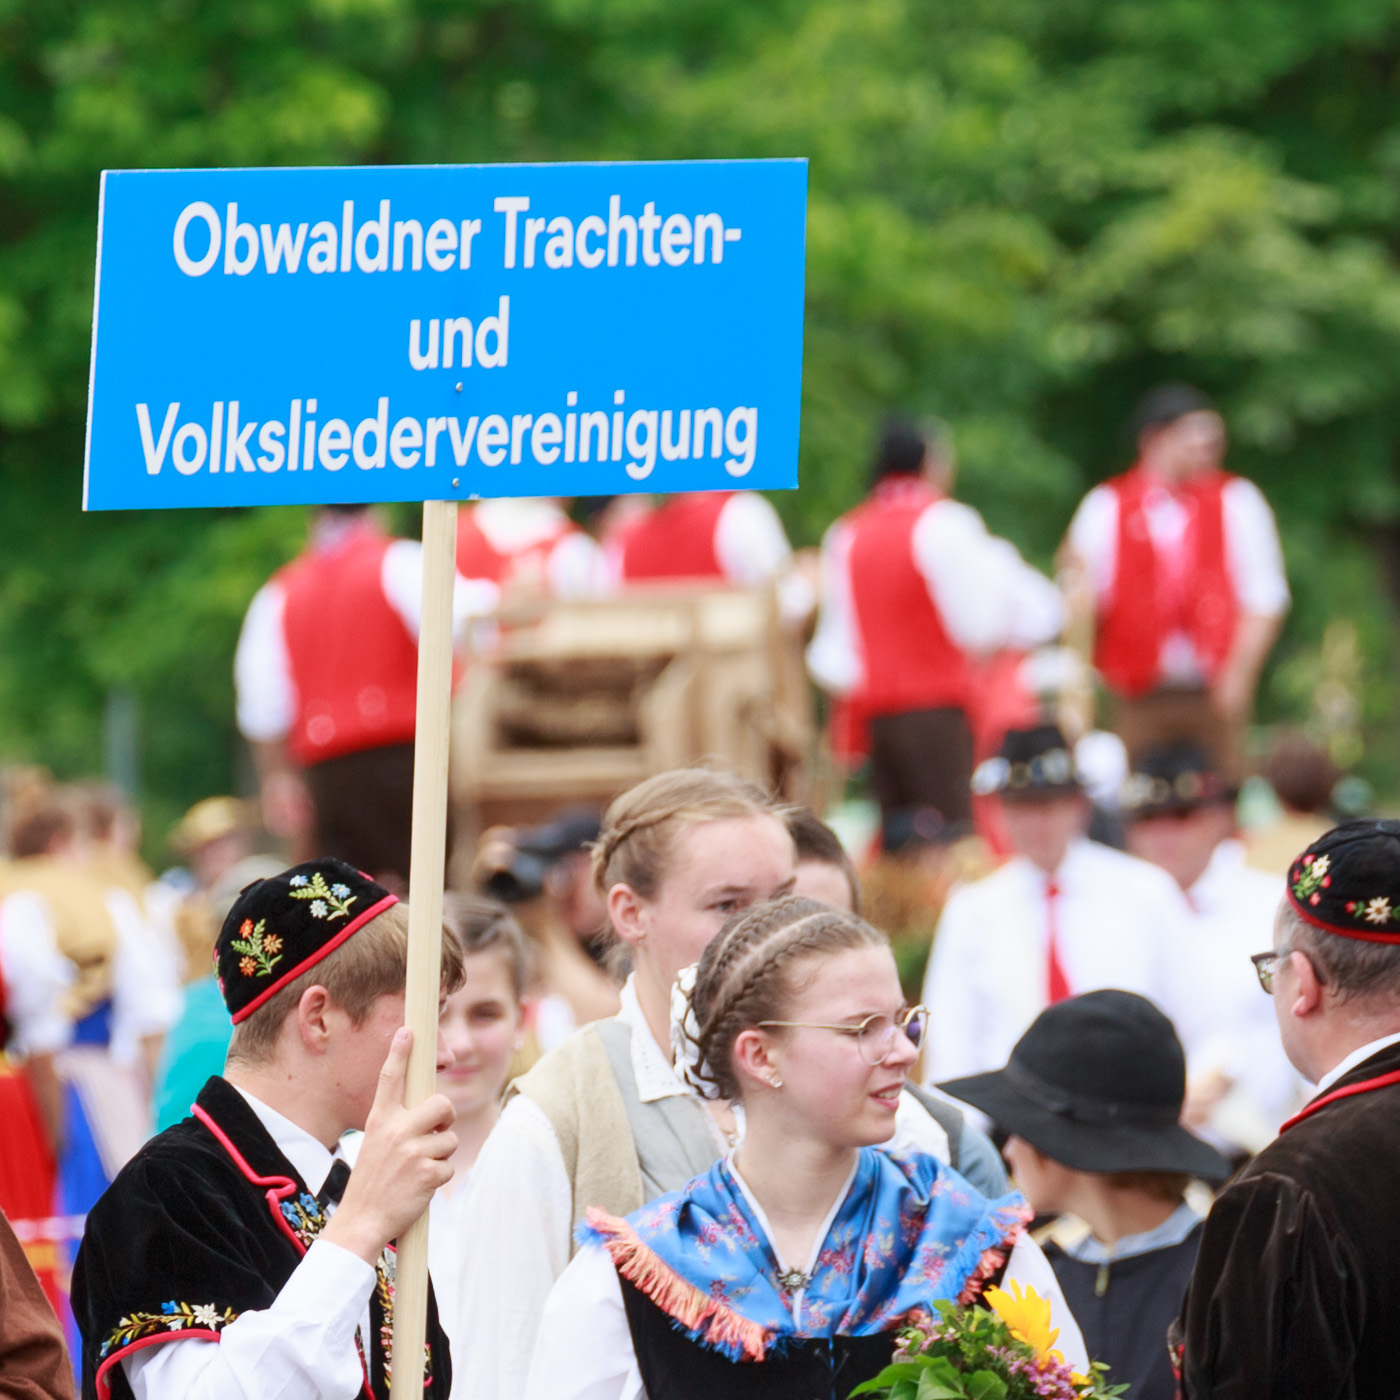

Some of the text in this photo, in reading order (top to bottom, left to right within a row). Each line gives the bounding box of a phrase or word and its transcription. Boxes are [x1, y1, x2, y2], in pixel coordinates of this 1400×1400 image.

[172, 193, 742, 278] Obwaldner Trachten-
[408, 294, 510, 371] und
[135, 389, 758, 481] Volksliedervereinigung
